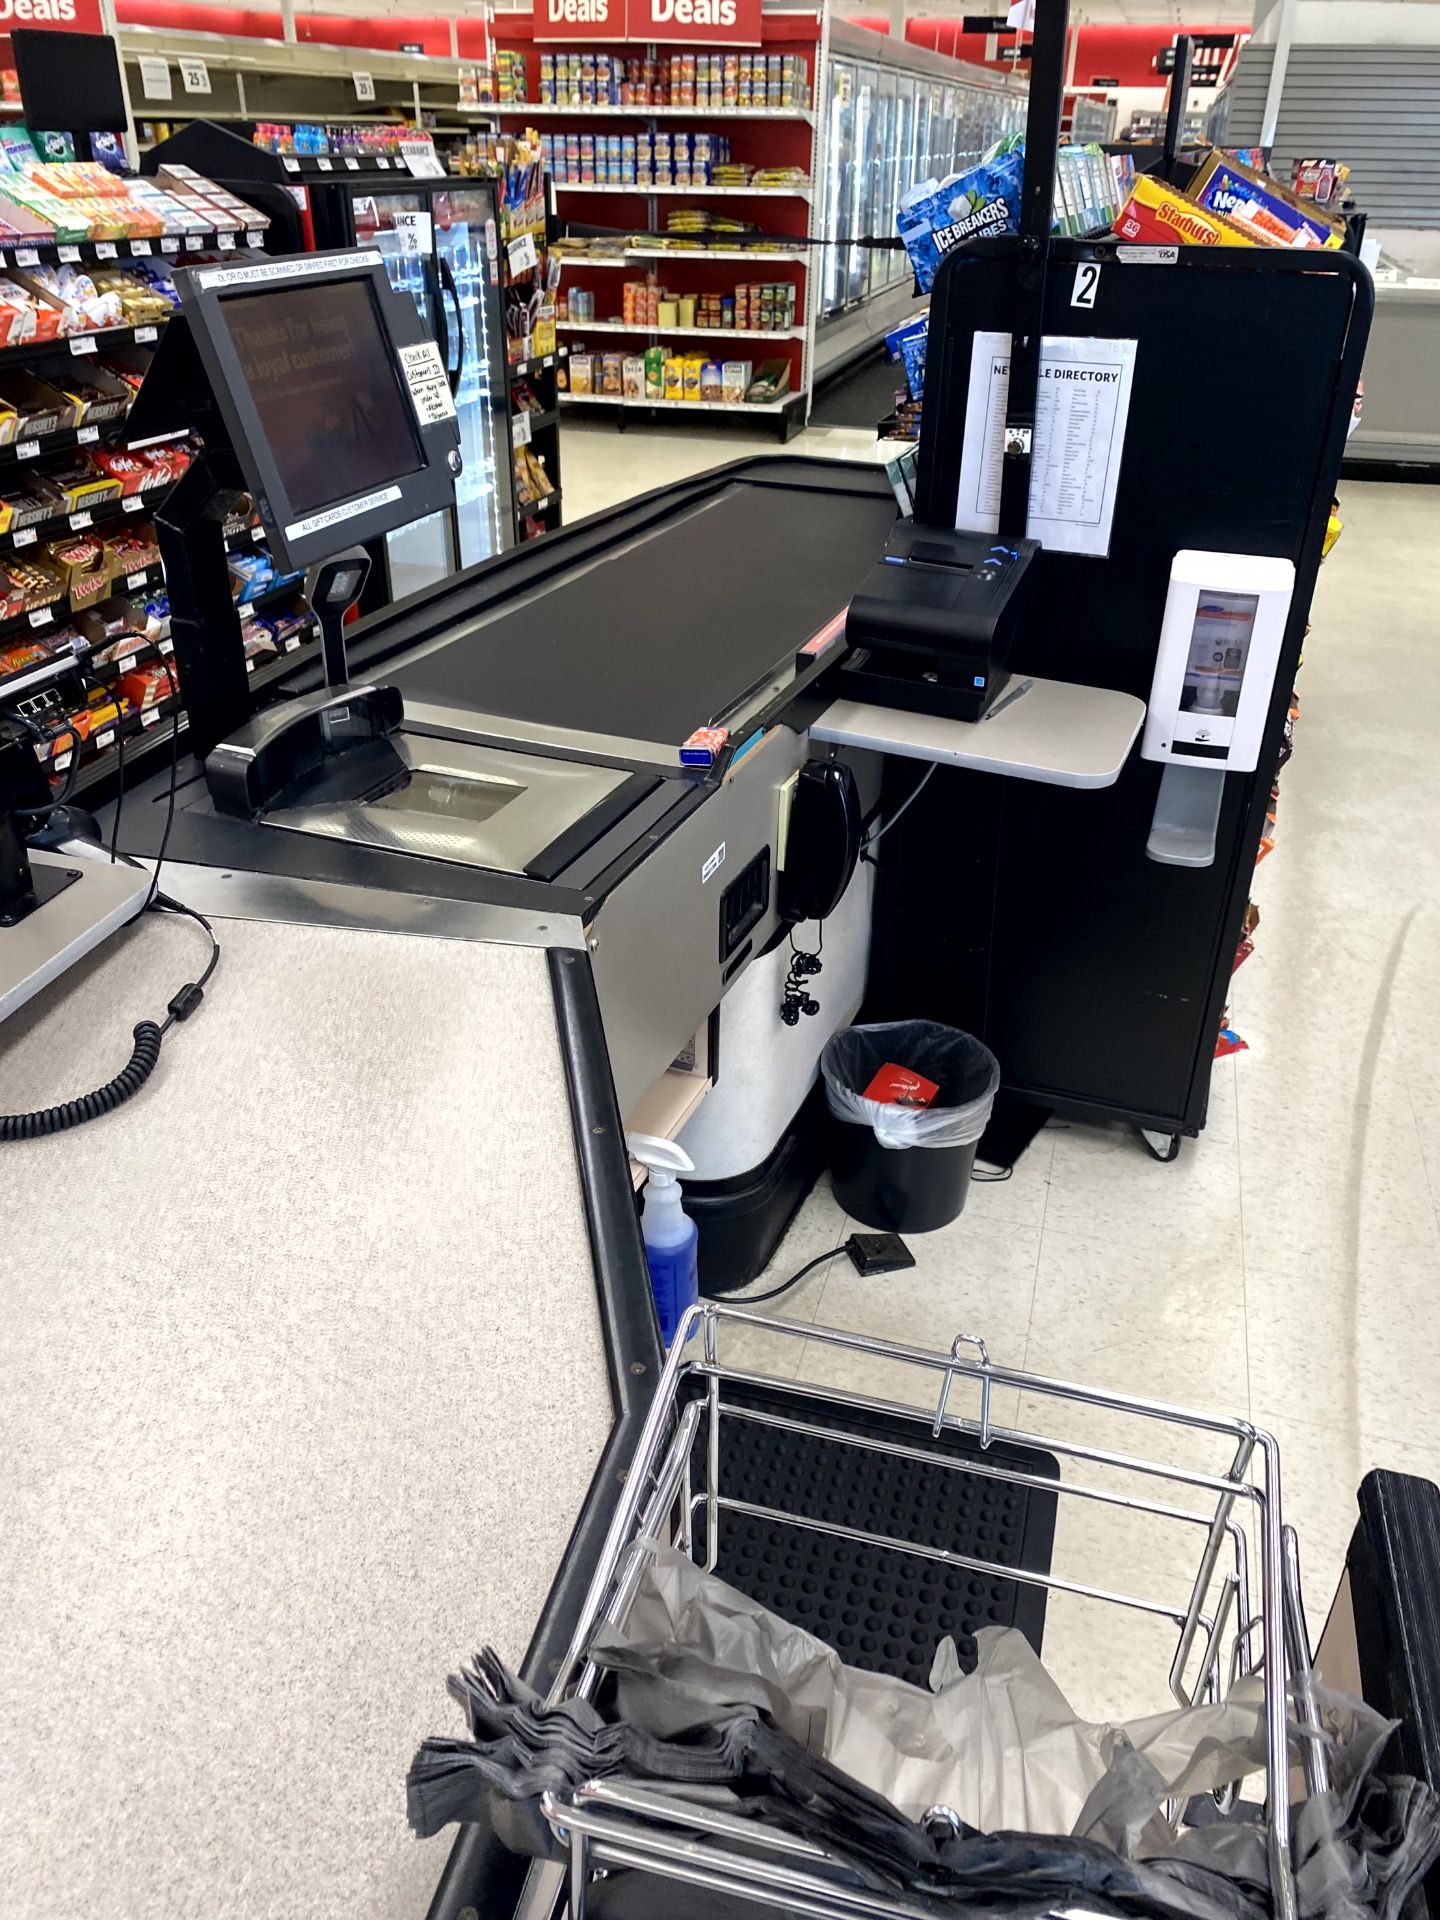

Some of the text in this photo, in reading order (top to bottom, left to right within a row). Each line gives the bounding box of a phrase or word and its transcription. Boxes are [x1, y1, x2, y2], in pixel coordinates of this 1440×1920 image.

[548, 0, 608, 22] Deals
[651, 0, 736, 26] Deals
[188, 71, 201, 87] 25
[932, 197, 1010, 254] ICE BREAKERS
[1125, 219, 1139, 233] 36
[1157, 201, 1221, 245] Starburst
[243, 268, 261, 280] MUST
[261, 268, 269, 278] BE
[338, 257, 350, 266] FOR
[349, 255, 370, 265] CHECKS
[1076, 266, 1097, 304] 2
[1054, 368, 1119, 383] DIRECTORY
[86, 401, 119, 419] HERSHEY'S
[24, 415, 58, 435] HERSHEY'S
[77, 489, 109, 508] HERSHEY'S
[19, 505, 54, 527] HERSHEY'S
[324, 511, 343, 523] CARDS
[342, 499, 369, 516] CUSTOMER
[25, 592, 62, 612] HEATH
